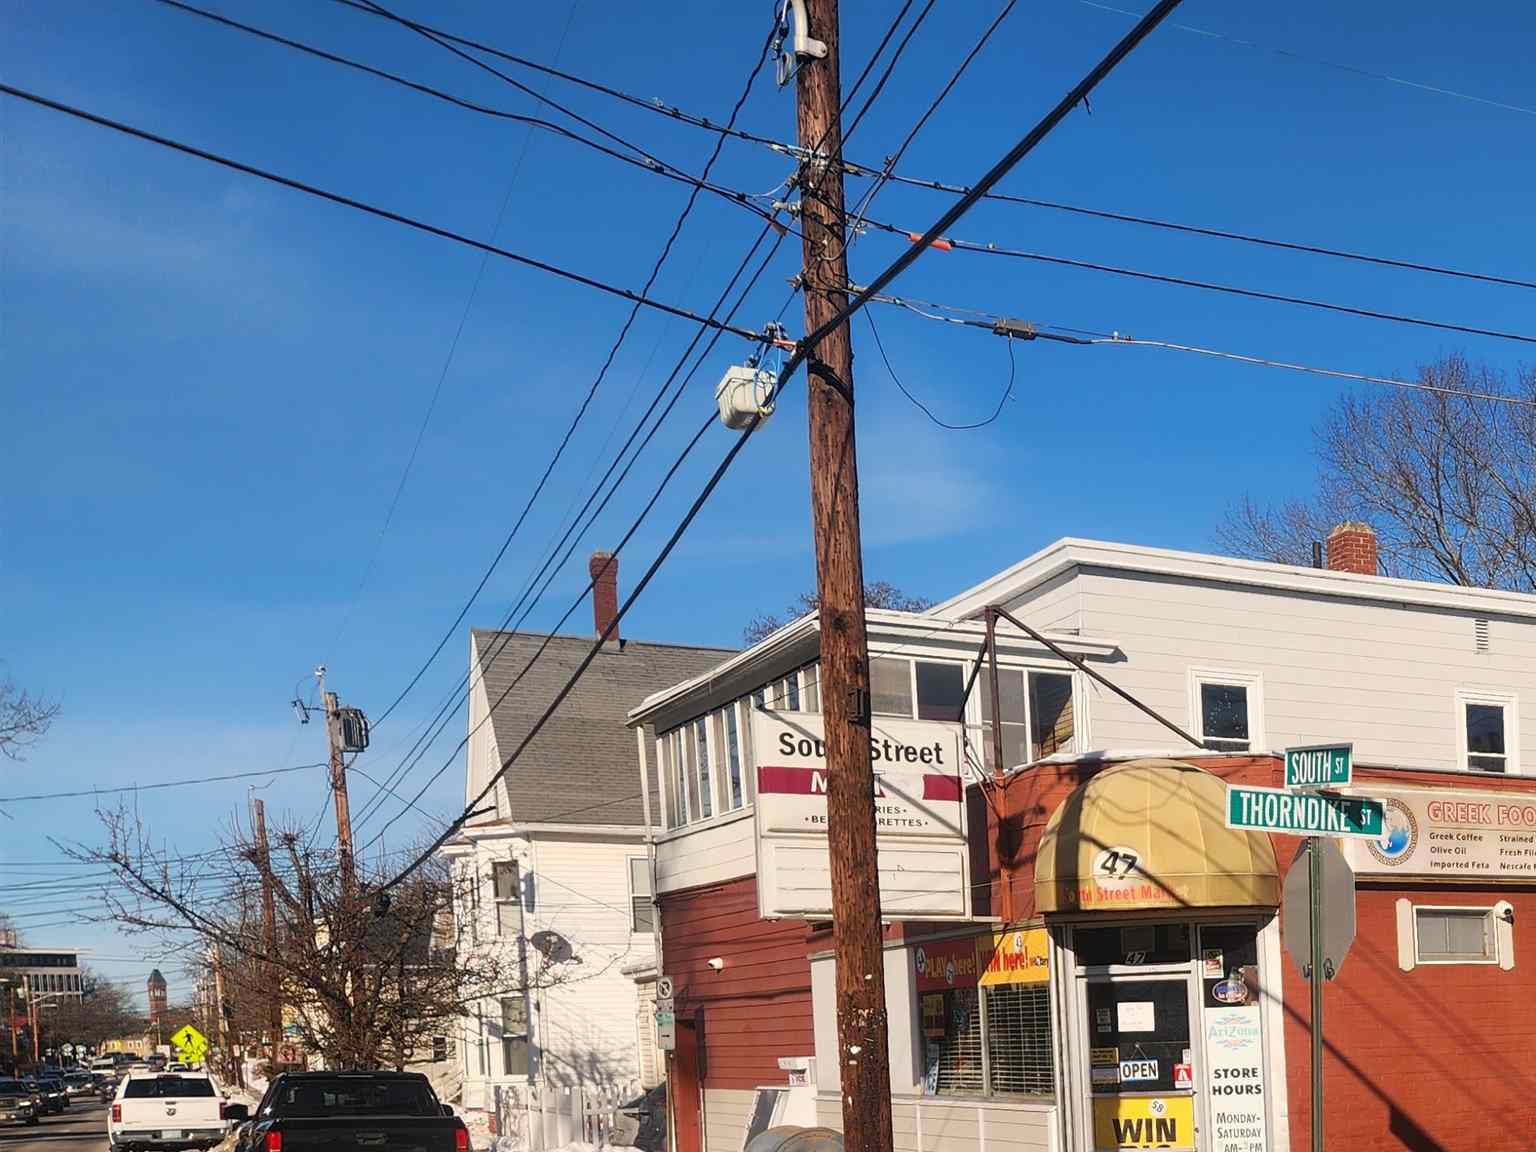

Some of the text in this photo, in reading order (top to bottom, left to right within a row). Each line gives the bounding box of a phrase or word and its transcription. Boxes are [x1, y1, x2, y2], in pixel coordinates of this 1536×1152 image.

[778, 731, 944, 765] Sou Street
[1291, 751, 1345, 784] SOUTH ST
[1239, 791, 1372, 832] THORNDIKE ST
[1427, 801, 1491, 825] GREEK
[1429, 832, 1483, 842] Greek Coffee
[1499, 835, 1534, 844] Strained
[1430, 846, 1467, 855] Olive Oil
[1499, 848, 1522, 857] Fresh
[1100, 851, 1138, 880] 47
[1430, 861, 1490, 870] Imported Feta
[1096, 885, 1137, 903] Street
[1122, 1062, 1157, 1079] OPEN
[1213, 1067, 1259, 1079] STORE
[1212, 1084, 1262, 1096] HOURS
[1112, 1118, 1177, 1143] WIN
